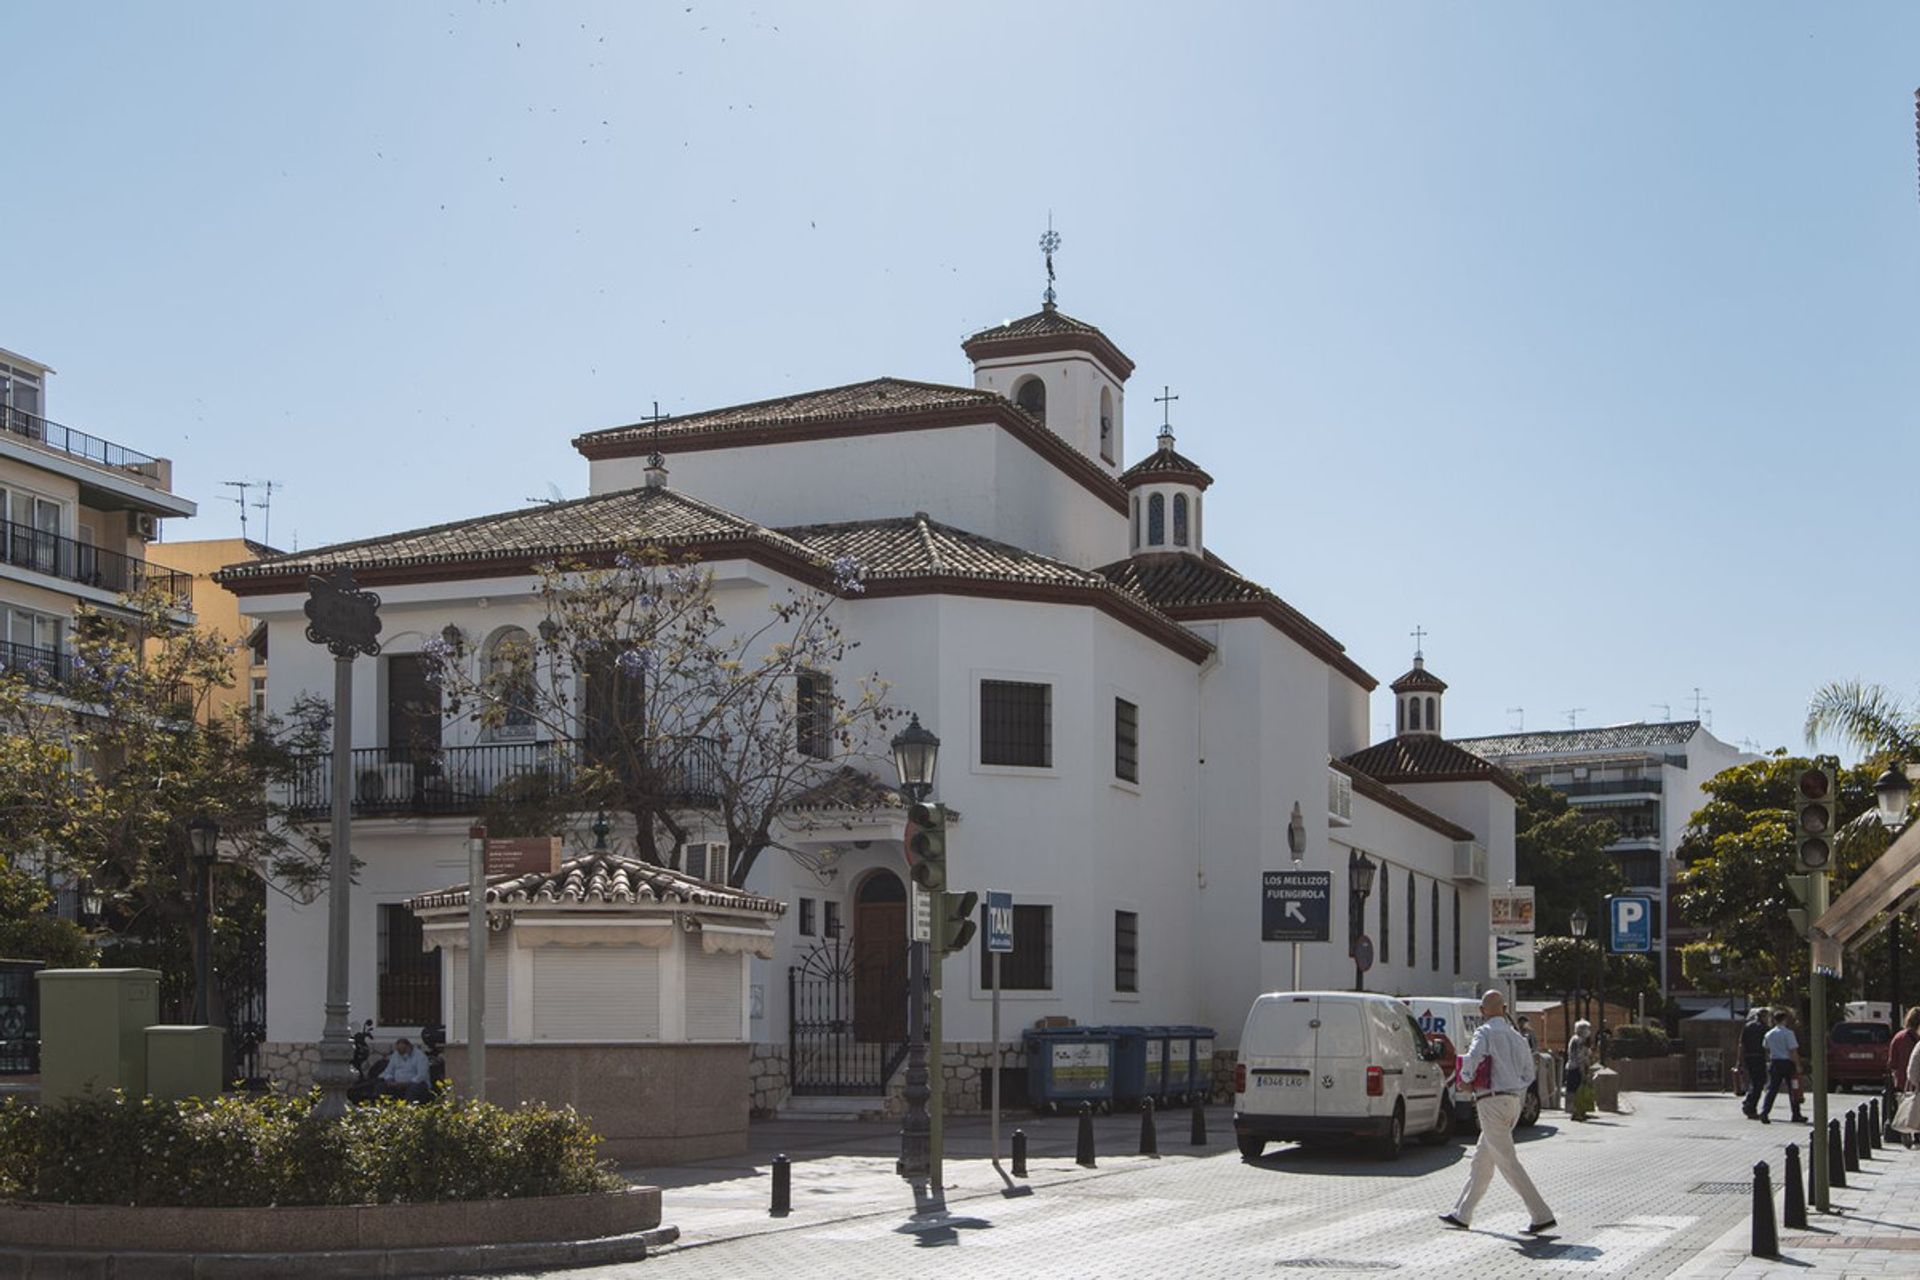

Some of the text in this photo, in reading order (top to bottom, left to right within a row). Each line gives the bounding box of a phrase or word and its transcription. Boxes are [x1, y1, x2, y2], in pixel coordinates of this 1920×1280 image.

[1264, 876, 1329, 886] LOS MELLIZOS
[1267, 889, 1326, 899] FUENGIROLA
[1618, 902, 1643, 933] P
